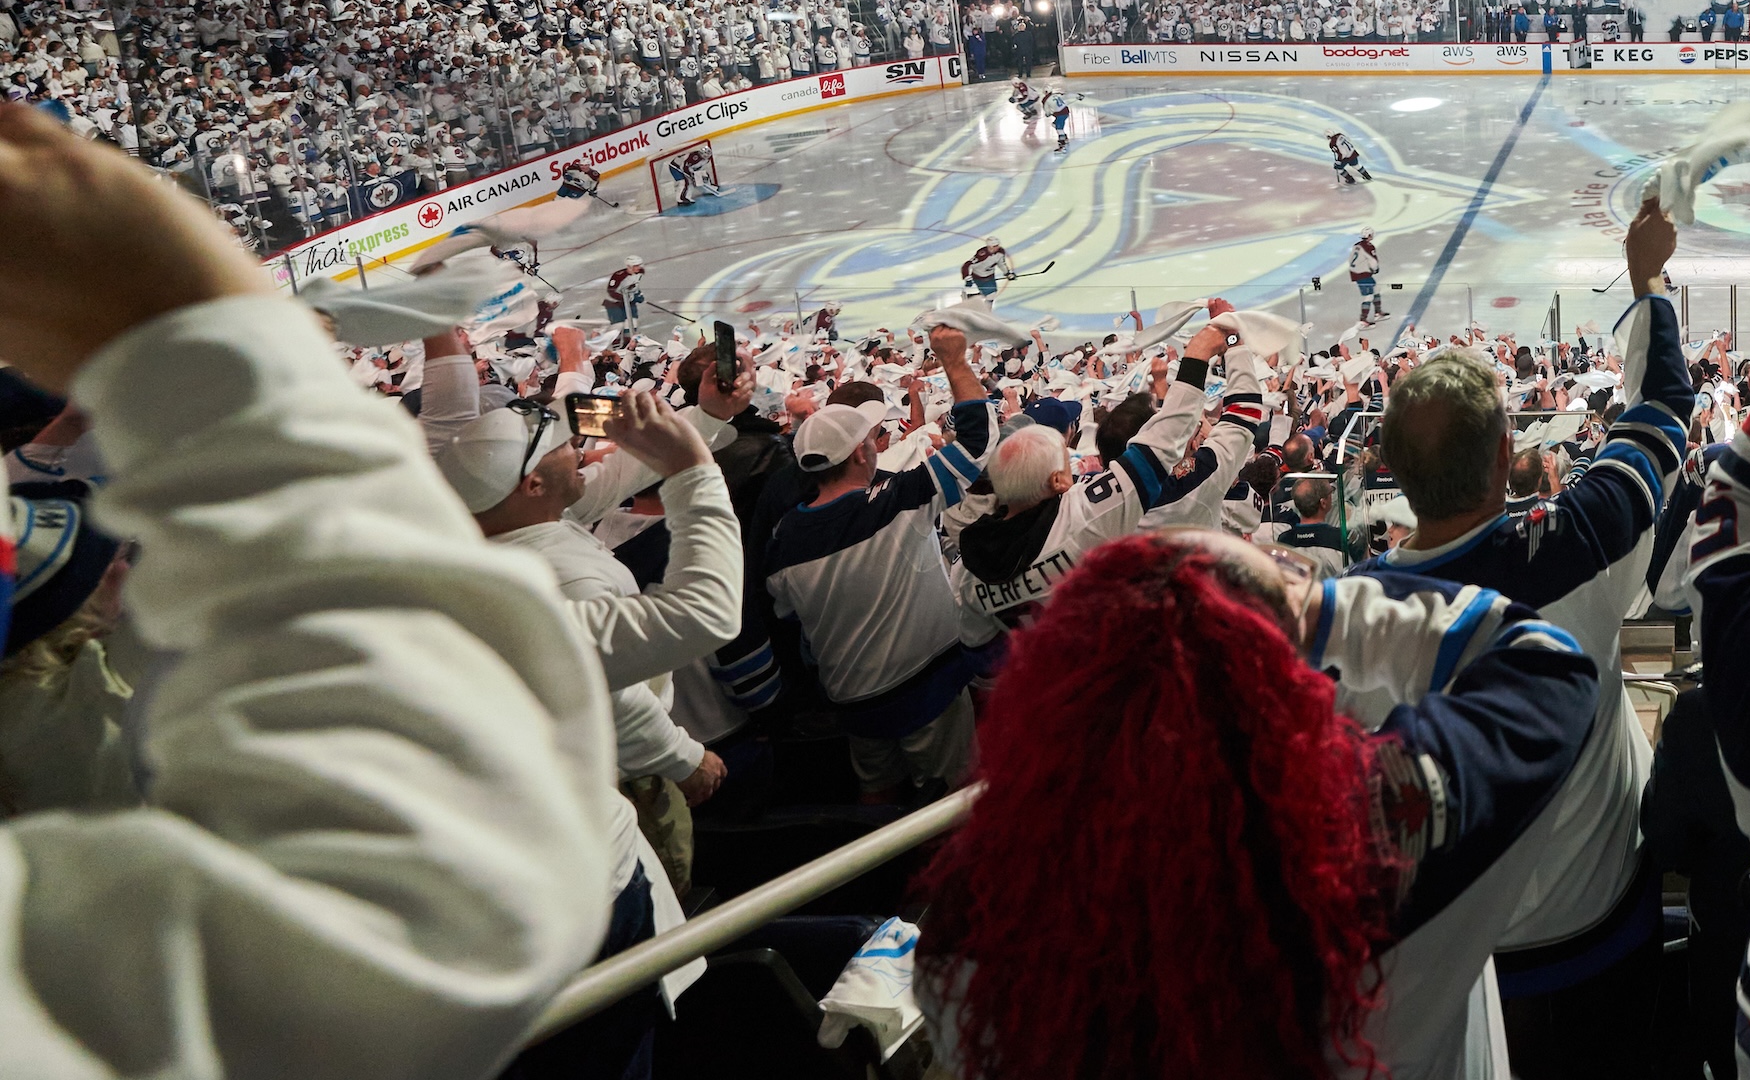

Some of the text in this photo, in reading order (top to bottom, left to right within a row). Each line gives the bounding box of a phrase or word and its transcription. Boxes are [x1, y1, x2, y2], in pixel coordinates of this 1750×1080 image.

[1083, 52, 1111, 65] Fibe
[1200, 50, 1298, 62] NISSAN
[1322, 46, 1410, 60] bodog.net
[1614, 48, 1653, 61] KEG
[885, 60, 926, 80] SN
[781, 79, 845, 102] canada life
[1583, 98, 1732, 106] NISSAN
[656, 99, 748, 138] Great Clips
[447, 171, 542, 216] AIR CANADA
[1572, 182, 1609, 208] Life
[348, 222, 410, 258] express
[975, 550, 1076, 611] PERFETTI
